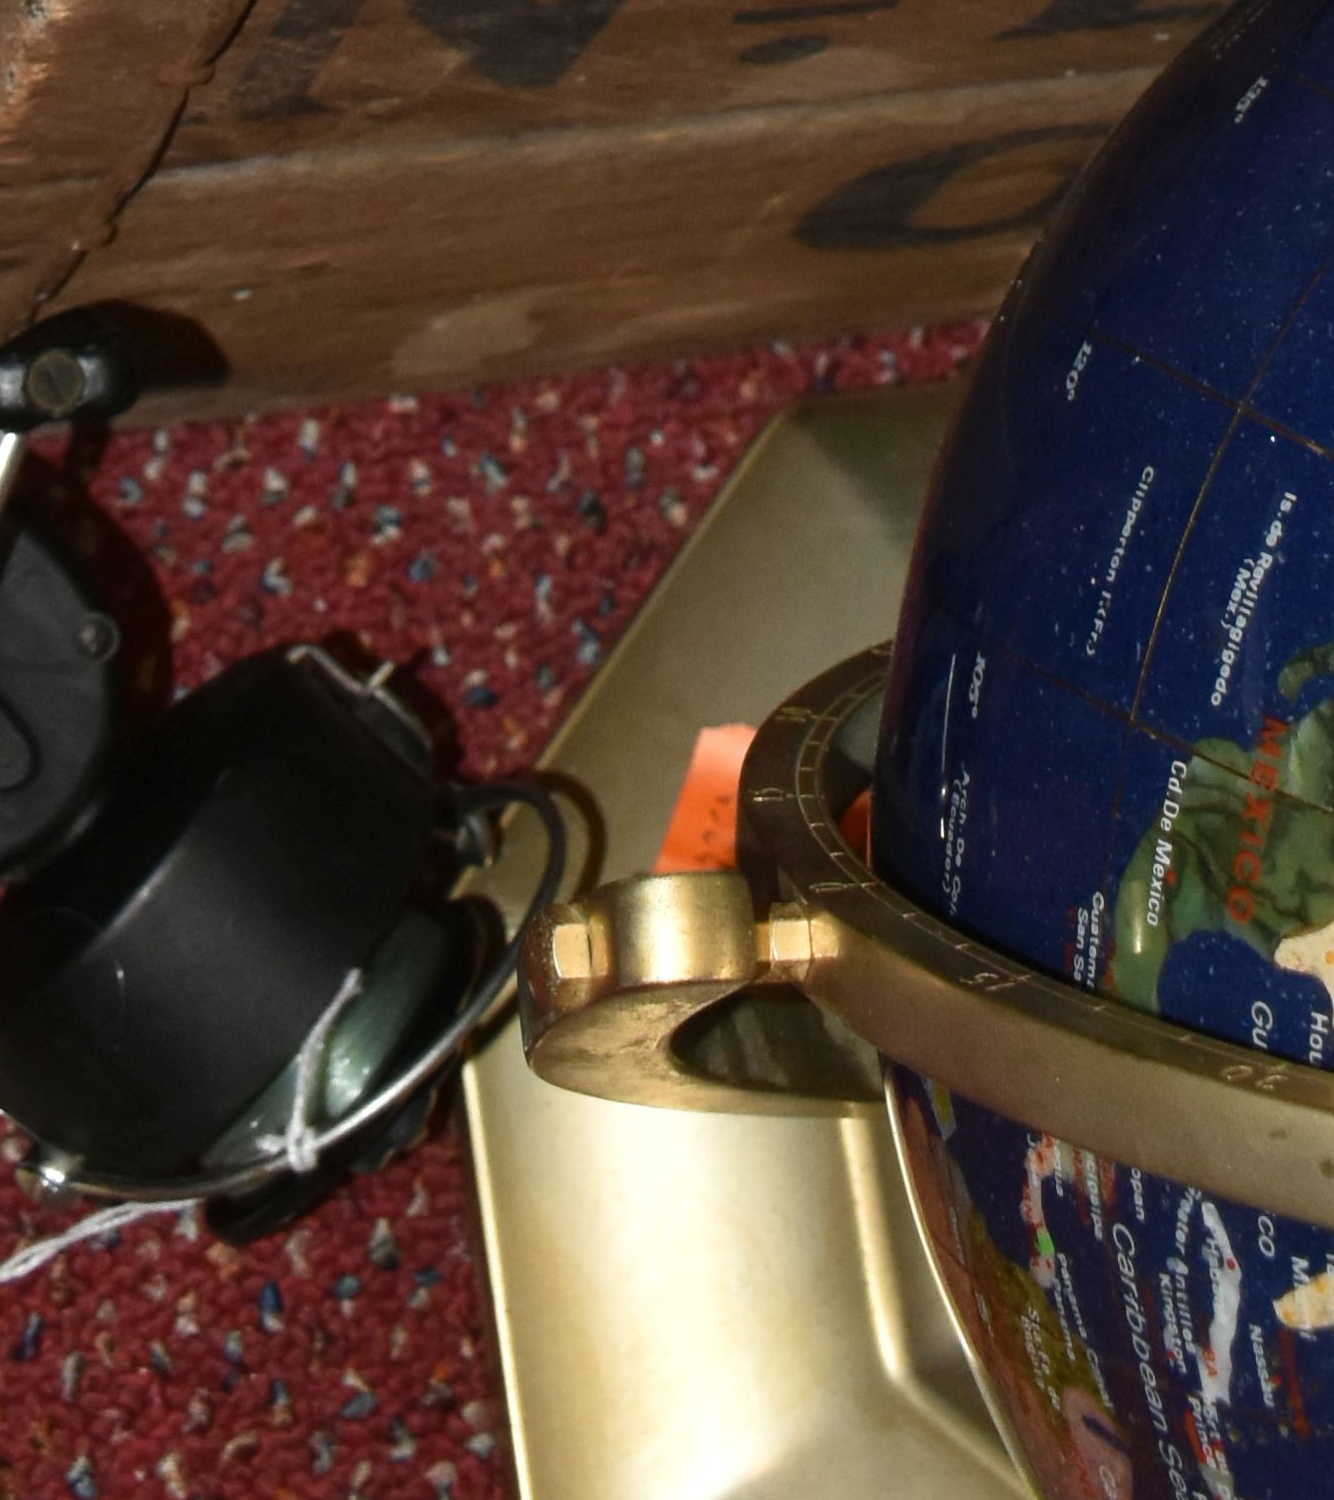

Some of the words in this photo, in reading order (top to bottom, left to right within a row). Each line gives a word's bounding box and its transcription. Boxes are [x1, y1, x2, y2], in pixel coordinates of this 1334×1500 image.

[1146, 838, 1175, 927] Mexico
[1225, 714, 1289, 926] MEXICO
[1112, 1221, 1168, 1433] Caribbean
[1248, 1323, 1275, 1410] Nassau
